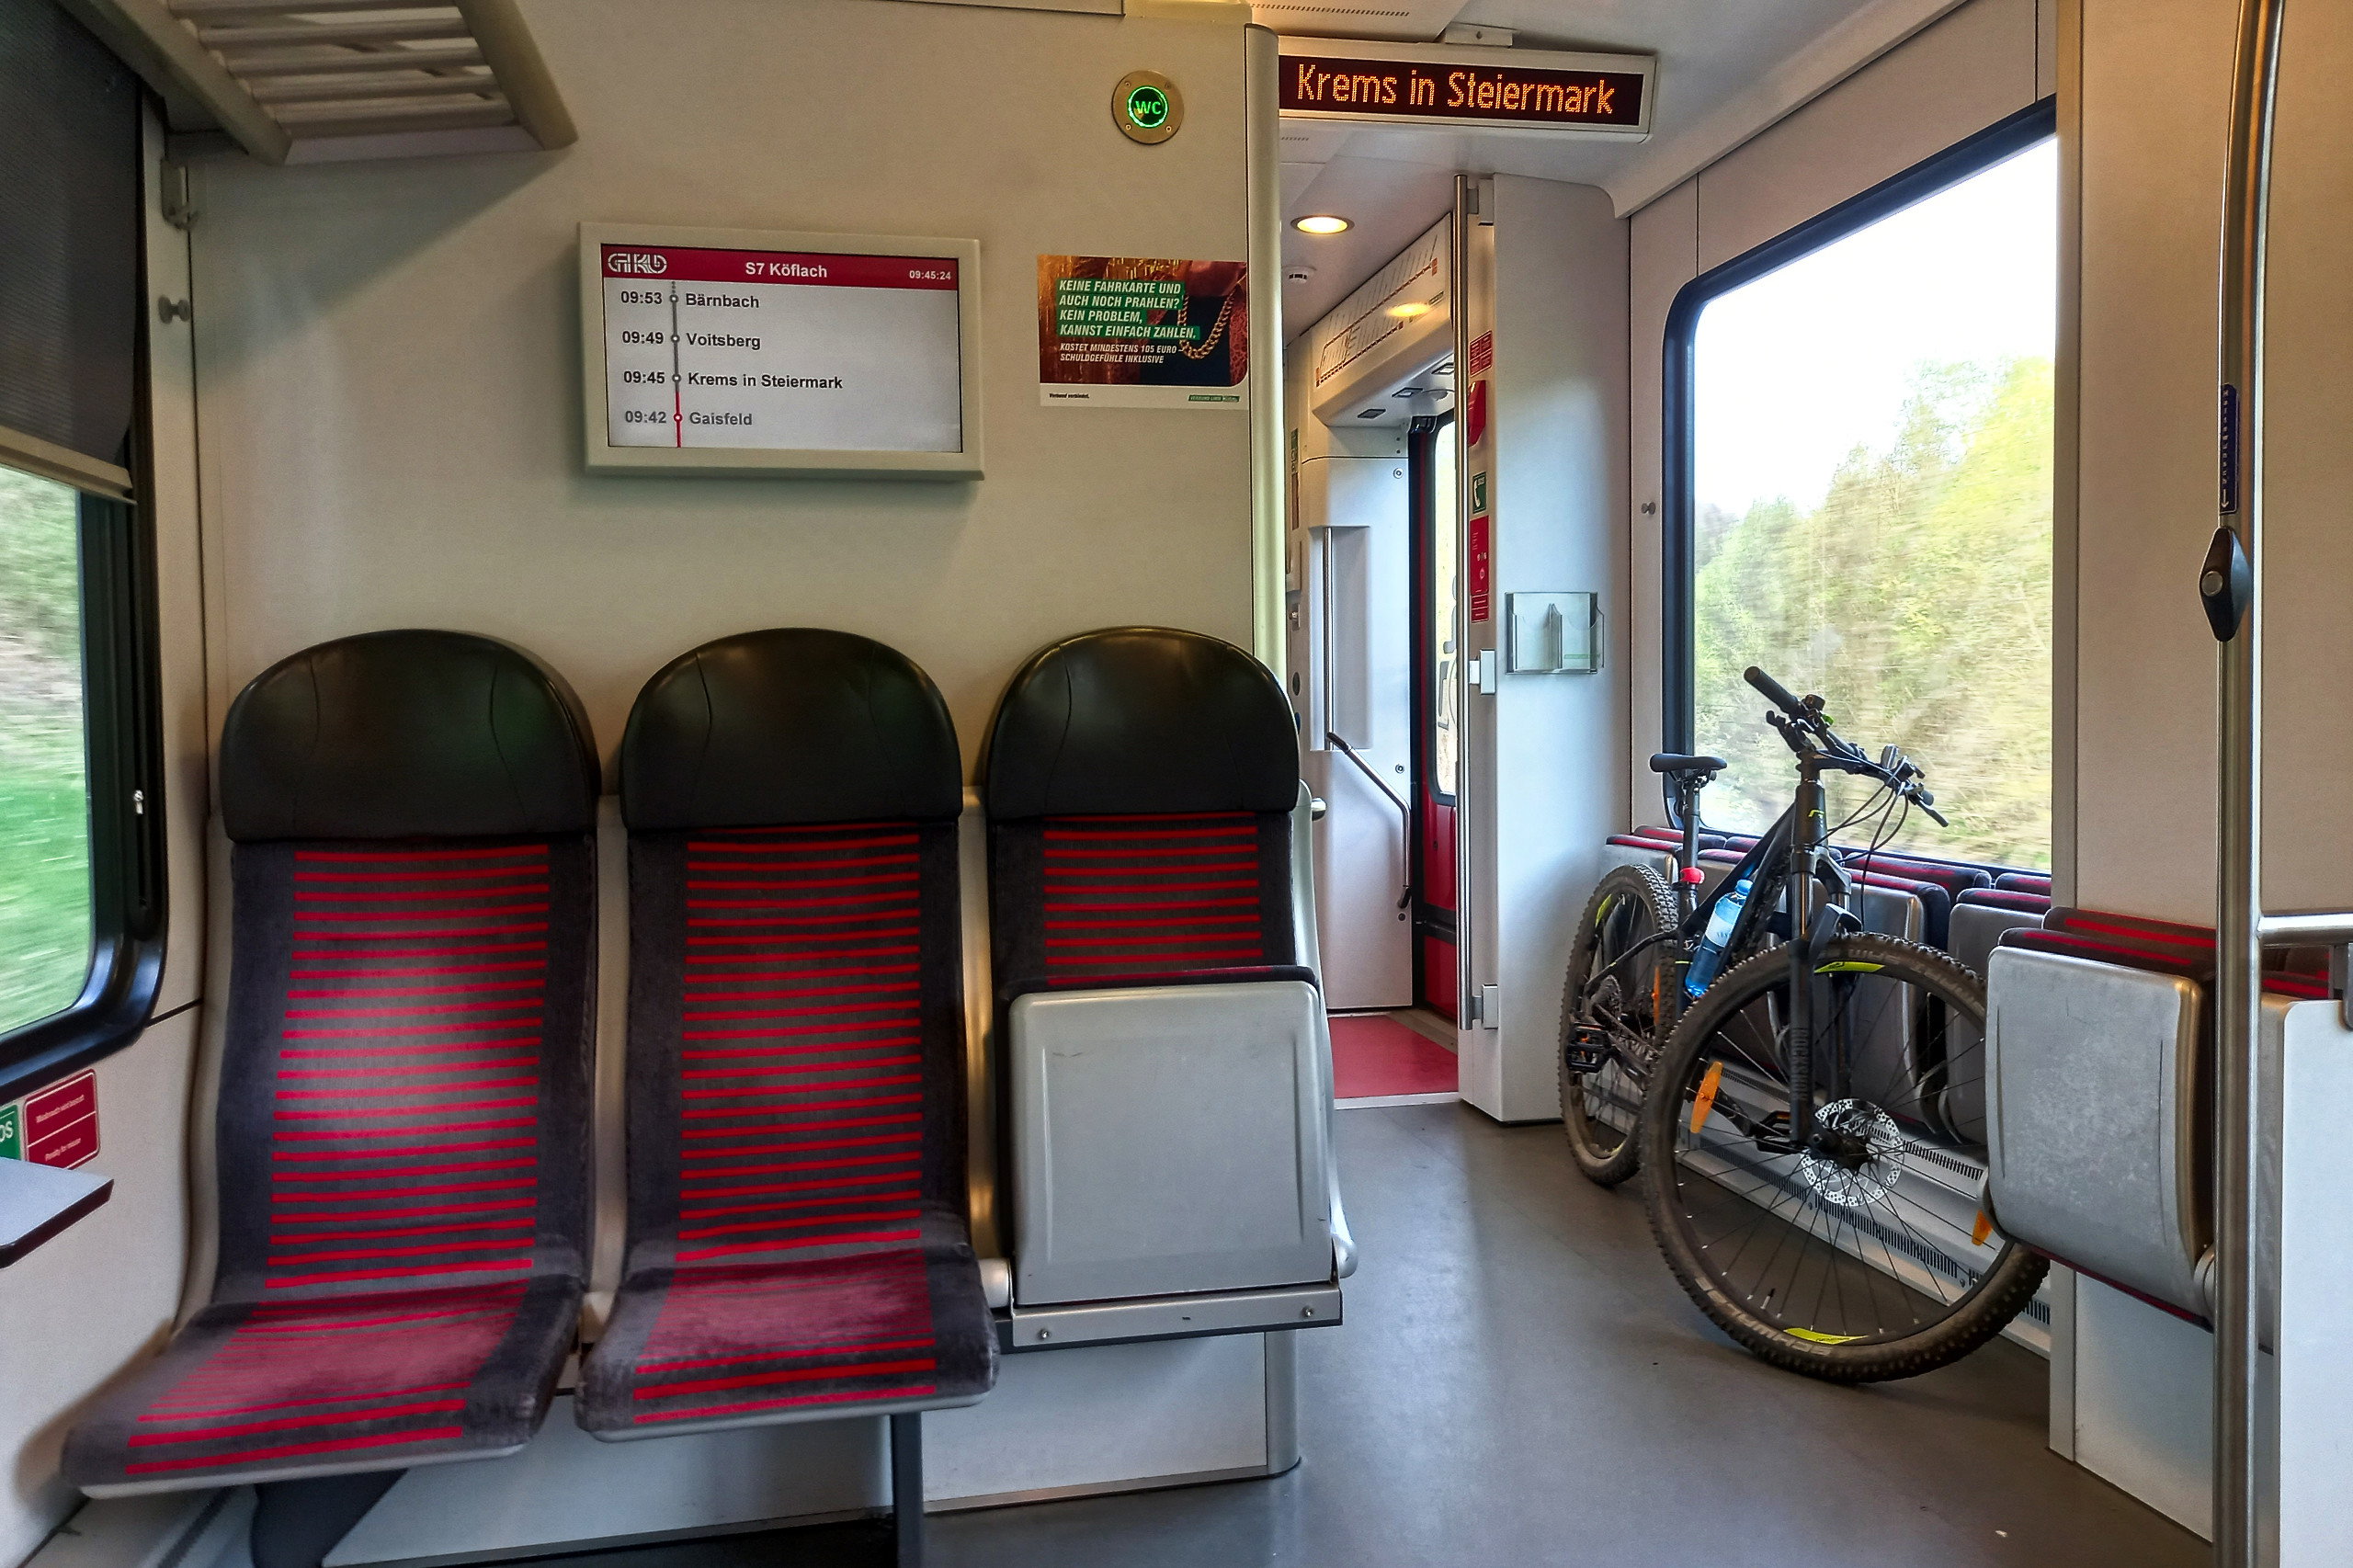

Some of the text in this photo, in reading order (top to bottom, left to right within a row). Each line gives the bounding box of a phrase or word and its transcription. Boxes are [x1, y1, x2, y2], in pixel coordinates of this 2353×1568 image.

[1298, 63, 1616, 114] Krems in Steiermark
[1135, 100, 1162, 115] WC
[745, 261, 827, 278] S7 Köflach
[908, 269, 952, 281] 09:45:24
[1059, 279, 1181, 294] KEINE FAHRKARTE UND
[620, 290, 760, 309] 09:53 Bärnbach
[1059, 295, 1180, 309] AUCH NOCH PRAHLEN?
[1059, 310, 1143, 324] KEIN PROBLEM,
[1060, 324, 1197, 338] KANNST EINFACH ZAHLEN.
[622, 331, 761, 350] 09:49 Voitsberg
[1060, 343, 1089, 351] KOSTET
[1090, 344, 1138, 353] MINDESTENS
[1141, 345, 1154, 353] 105
[1156, 346, 1176, 354] EURO
[1060, 353, 1164, 364] SCHULDGEFÜHLE INKLUSIVE
[623, 370, 843, 390] 09:45 Krems in Steiermark
[624, 410, 753, 426] 09:42 Gaisfeld
